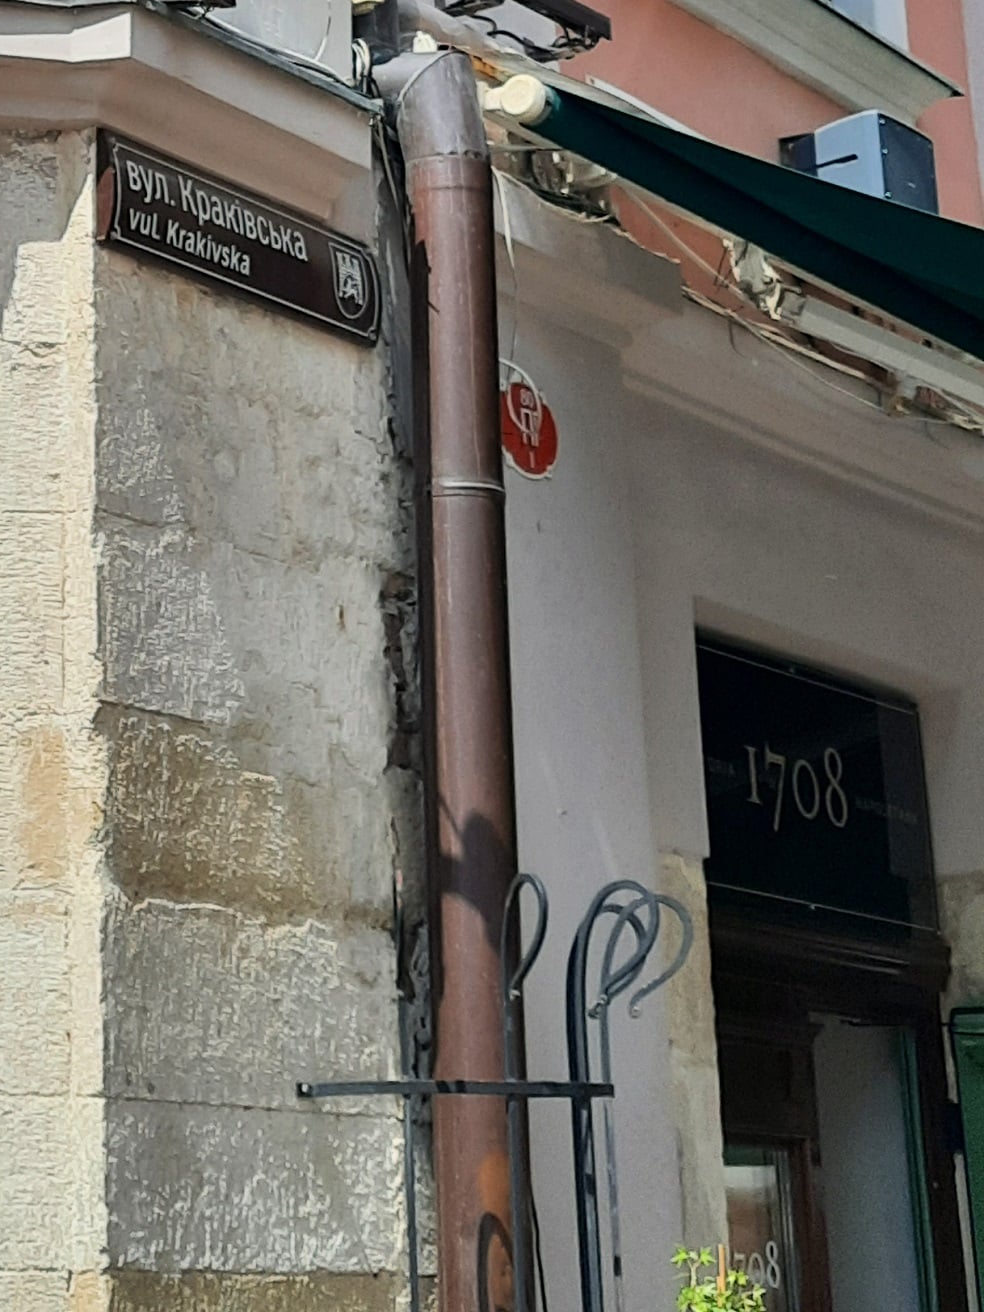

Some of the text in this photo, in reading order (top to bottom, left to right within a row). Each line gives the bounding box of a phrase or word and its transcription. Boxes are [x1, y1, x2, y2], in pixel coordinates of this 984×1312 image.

[126, 160, 309, 263] вул. Краківська
[166, 219, 251, 277] Krakivska
[744, 743, 848, 832] 1708
